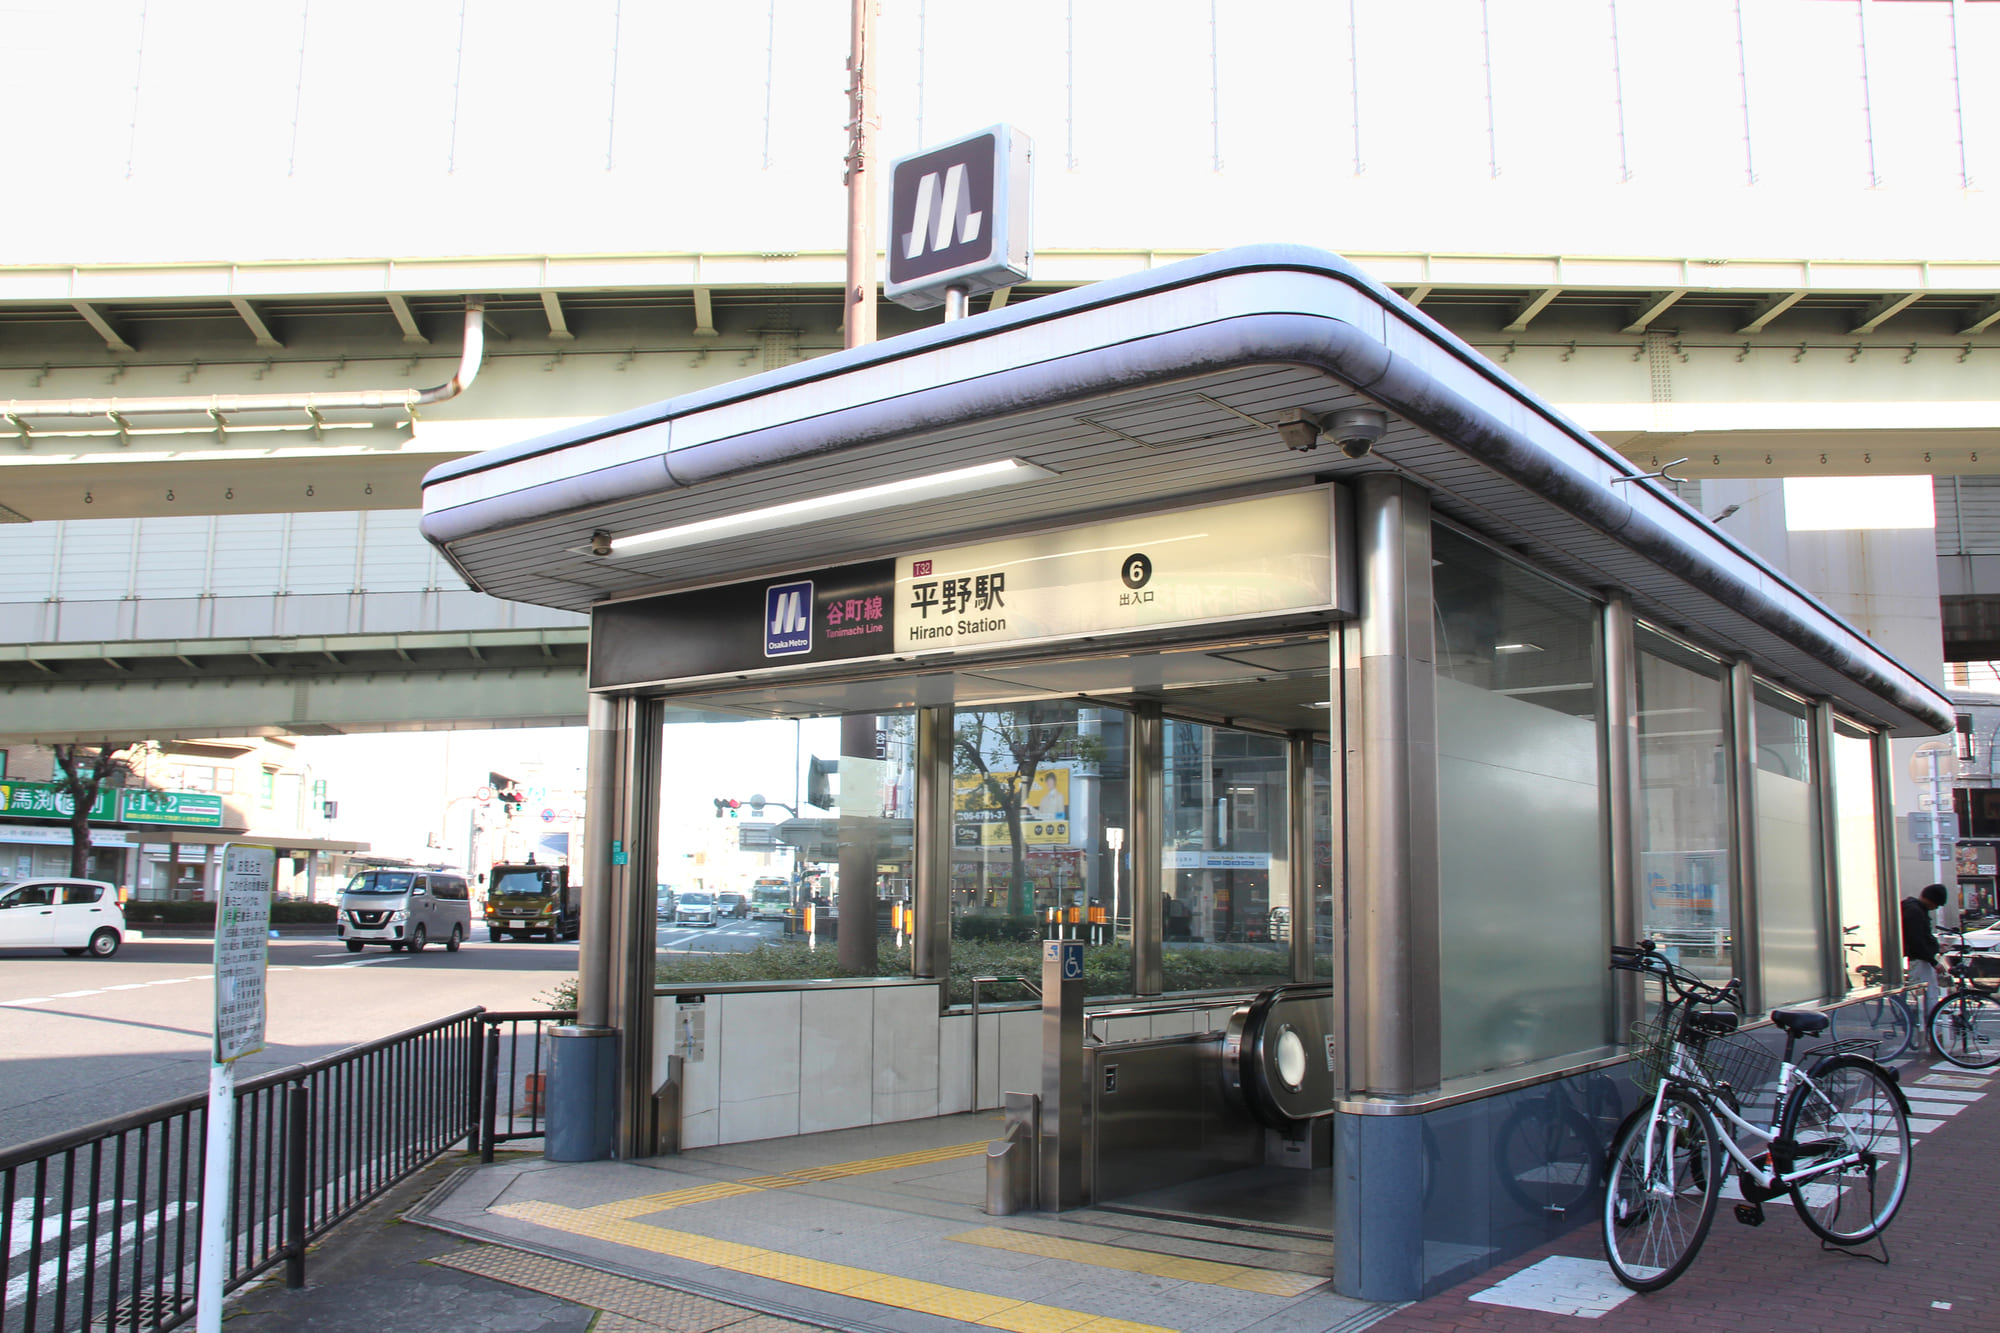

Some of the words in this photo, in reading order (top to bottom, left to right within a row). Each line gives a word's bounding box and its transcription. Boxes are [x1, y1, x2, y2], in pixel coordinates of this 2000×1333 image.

[914, 562, 931, 576] T32
[1129, 560, 1144, 582] 6
[910, 572, 1005, 619] 平野駅
[1119, 591, 1154, 606] 出入口
[826, 595, 884, 626] 谷町線
[825, 625, 864, 639] Tanimachi
[865, 623, 884, 634] Line
[910, 624, 954, 641] Hirano
[957, 617, 1006, 635] Station
[768, 640, 789, 650] Osaka
[788, 638, 808, 648] Metro
